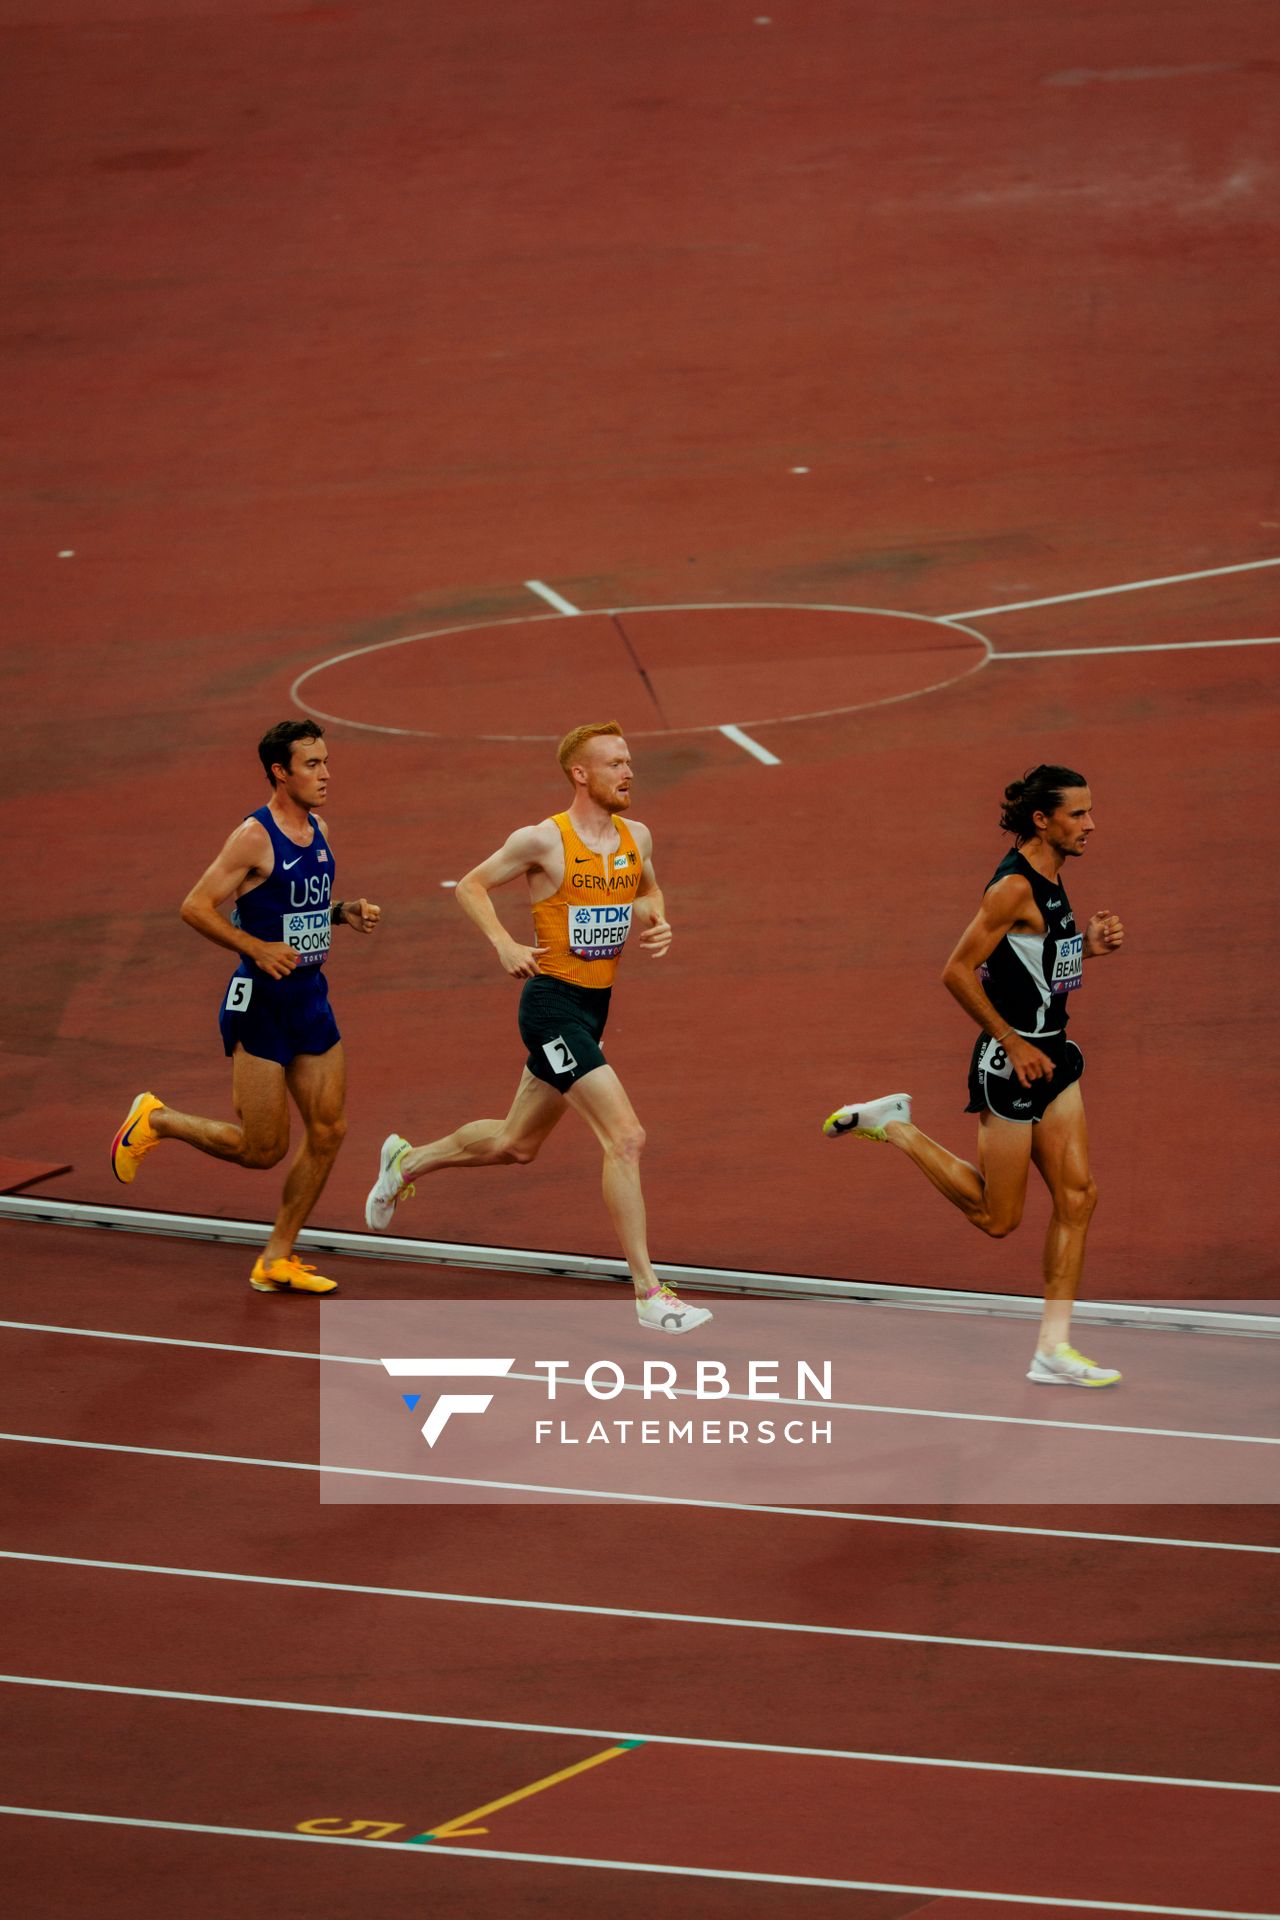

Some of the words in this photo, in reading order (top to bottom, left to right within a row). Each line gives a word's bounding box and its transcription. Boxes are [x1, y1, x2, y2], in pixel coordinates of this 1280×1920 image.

[290, 873, 331, 908] USA
[572, 873, 640, 892] GERMANY
[303, 911, 330, 930] TDK
[590, 906, 631, 924] TDK
[573, 925, 629, 945] RUPPERT
[588, 946, 620, 957] TOKYO
[232, 982, 246, 1006] 5
[554, 1043, 574, 1067] 2
[989, 1045, 1008, 1070] 8
[295, 1817, 406, 1839] 5
